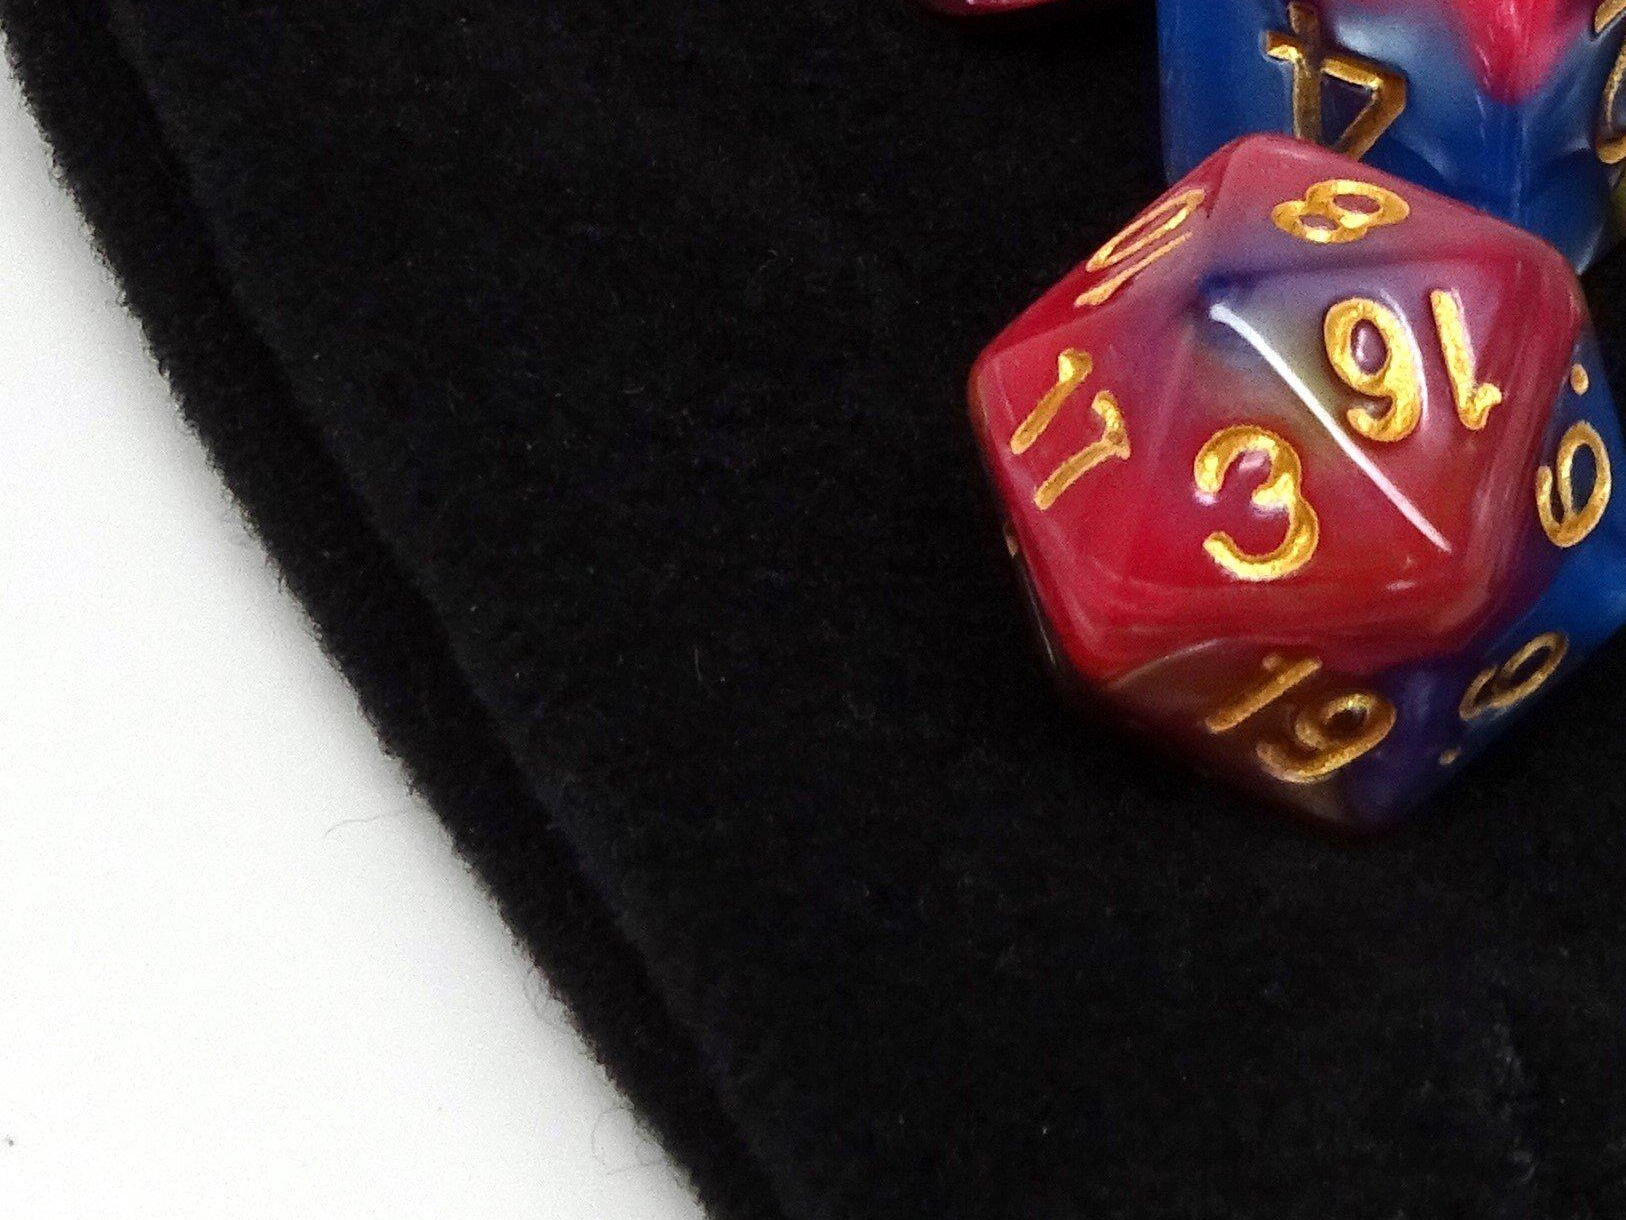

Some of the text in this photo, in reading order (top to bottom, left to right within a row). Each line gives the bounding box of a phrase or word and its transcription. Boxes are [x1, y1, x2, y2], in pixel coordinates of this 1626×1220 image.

[1074, 187, 1207, 307] 10
[1271, 179, 1410, 244] 8
[1009, 346, 1132, 512] 17
[1322, 287, 1503, 444] 16
[1192, 423, 1320, 582] 3
[1204, 651, 1398, 785] 19
